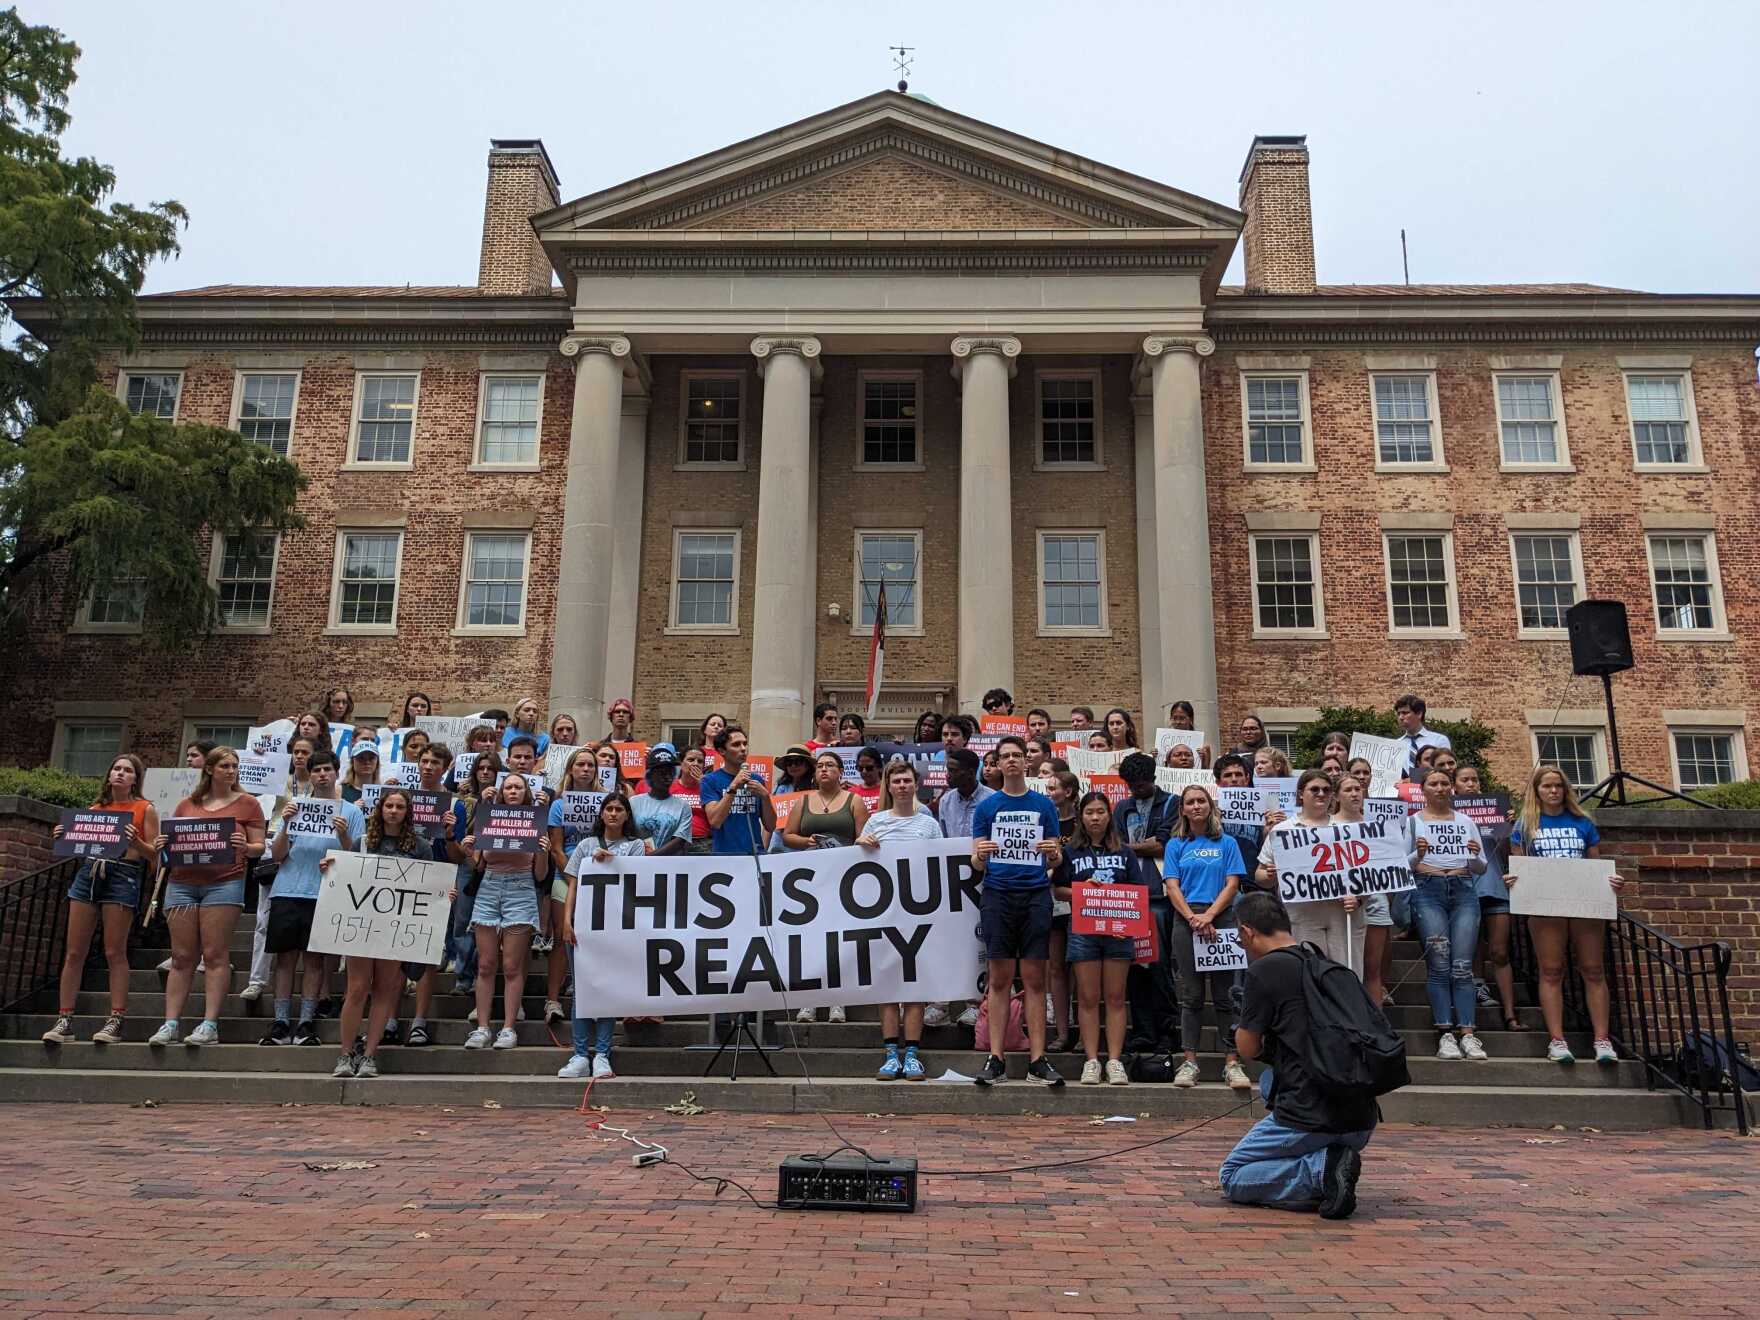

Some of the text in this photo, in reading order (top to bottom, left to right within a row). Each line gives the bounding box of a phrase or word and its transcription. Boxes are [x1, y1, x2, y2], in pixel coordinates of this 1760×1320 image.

[985, 723, 1026, 732] WE CAN END
[274, 737, 282, 746] IS
[1354, 740, 1401, 770] FUCK
[752, 764, 766, 772] END
[407, 775, 420, 783] OU
[1160, 770, 1192, 783] THOUGHTS
[1093, 784, 1125, 793] WE CAN
[425, 796, 437, 804] THE
[567, 795, 602, 805] THIS IS
[1223, 791, 1247, 801] THIS
[1250, 791, 1260, 801] IS
[776, 800, 787, 809] WE
[1231, 800, 1255, 811] OUR
[1486, 798, 1497, 806] THE
[296, 802, 334, 815] THIS IS
[573, 804, 597, 814] OUR
[1368, 803, 1404, 814] THIS IS
[1488, 807, 1496, 815] OF
[75, 814, 119, 824] GUNS ARE THE
[302, 813, 327, 824] OUR
[419, 815, 441, 823] YOUTH
[490, 809, 509, 818] GUNS
[523, 811, 535, 819] THE
[564, 814, 599, 823] REALIT
[999, 814, 1031, 823] MARCH
[1221, 810, 1264, 821] REALITY
[491, 819, 500, 827] #1
[501, 819, 522, 827] KILLER
[1484, 816, 1505, 824] YOUTH
[74, 823, 115, 833] #1 KILLER OF
[174, 823, 221, 833] GUNS ARE THE
[289, 821, 336, 835] REALITY
[482, 828, 538, 837] AMERICAN YOUTH
[996, 827, 1036, 839] THIS IS
[1429, 825, 1466, 835] THIS IS
[65, 833, 120, 843] AMERICAN YOUTH
[177, 832, 219, 842] #1 KILLER OF
[1275, 828, 1321, 850] THIS
[1333, 824, 1351, 842] IS
[1359, 819, 1386, 839] MY
[1004, 839, 1029, 850] OUR
[1437, 835, 1462, 845] OUR
[1534, 838, 1585, 850] FOR OUR
[171, 842, 227, 851] AMERICAN YOUTH
[993, 849, 1040, 861] REALITY
[1193, 849, 1220, 857] VOTE
[1311, 840, 1370, 873] 2ND
[354, 855, 434, 884] TEXT
[1072, 857, 1094, 874] TAR
[1281, 866, 1414, 900] SCHOOL SHOOTING
[581, 854, 984, 931] THIS IS OUR
[1082, 888, 1139, 899] DIVEST FROM THE
[1086, 898, 1135, 908] GUN INDUSTRY.
[1081, 908, 1140, 919] #KILLERBUSINESS
[330, 913, 434, 956] 954-954
[1225, 932, 1235, 944] IS
[1207, 944, 1233, 956] OUR
[645, 923, 933, 997] REALITY
[1197, 954, 1244, 968] REALITY
